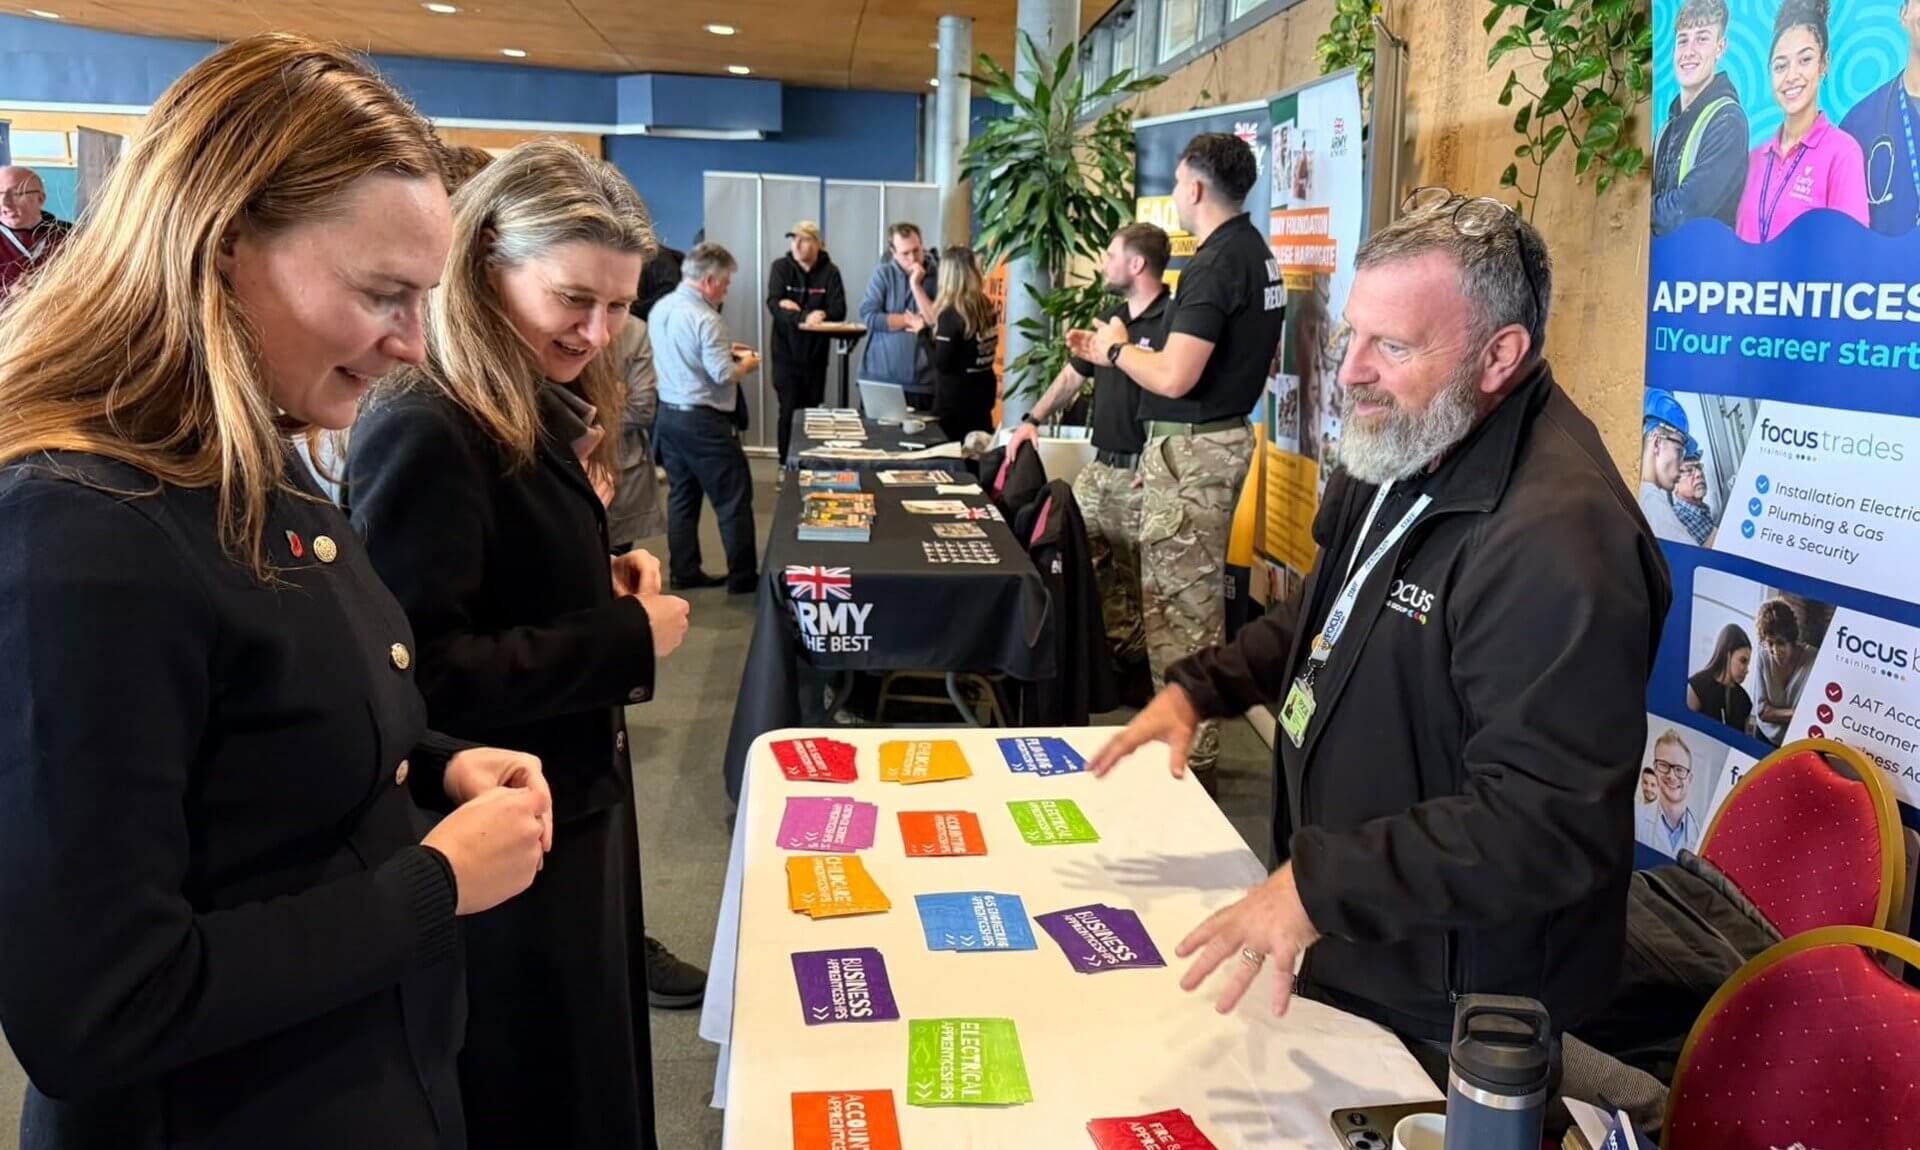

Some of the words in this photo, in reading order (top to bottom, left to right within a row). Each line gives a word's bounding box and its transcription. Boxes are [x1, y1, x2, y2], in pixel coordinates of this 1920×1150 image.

[1740, 335, 1831, 362] career
[1838, 338, 1920, 370] start
[1760, 418, 1819, 449] focus
[1821, 430, 1905, 462] trades
[1760, 447, 1793, 460] training
[1775, 482, 1855, 510] Installation
[1768, 505, 1835, 534] Plumbing
[1838, 520, 1849, 534] &
[1853, 523, 1885, 542] Gas
[1760, 527, 1784, 545] Fire
[1786, 534, 1796, 547] &
[1798, 537, 1860, 565] Security
[1391, 579, 1434, 612] OCUS
[1324, 609, 1344, 639] FOCUS
[830, 635, 872, 652] BEST
[1836, 626, 1908, 668] focus
[1836, 654, 1877, 674] training
[1849, 693, 1884, 714] AAT
[1841, 715, 1919, 753] Customer
[1062, 913, 1120, 965] APPRENTICESHIPS
[1074, 910, 1138, 961] BUSINESS
[827, 958, 849, 1020] APPRENTICESHIPS
[841, 957, 873, 1018] BUSINESS
[940, 1020, 955, 1100] APPRENTICESHIPS
[960, 1022, 982, 1099] ELECTRICAL
[1149, 1121, 1175, 1143] FIRE
